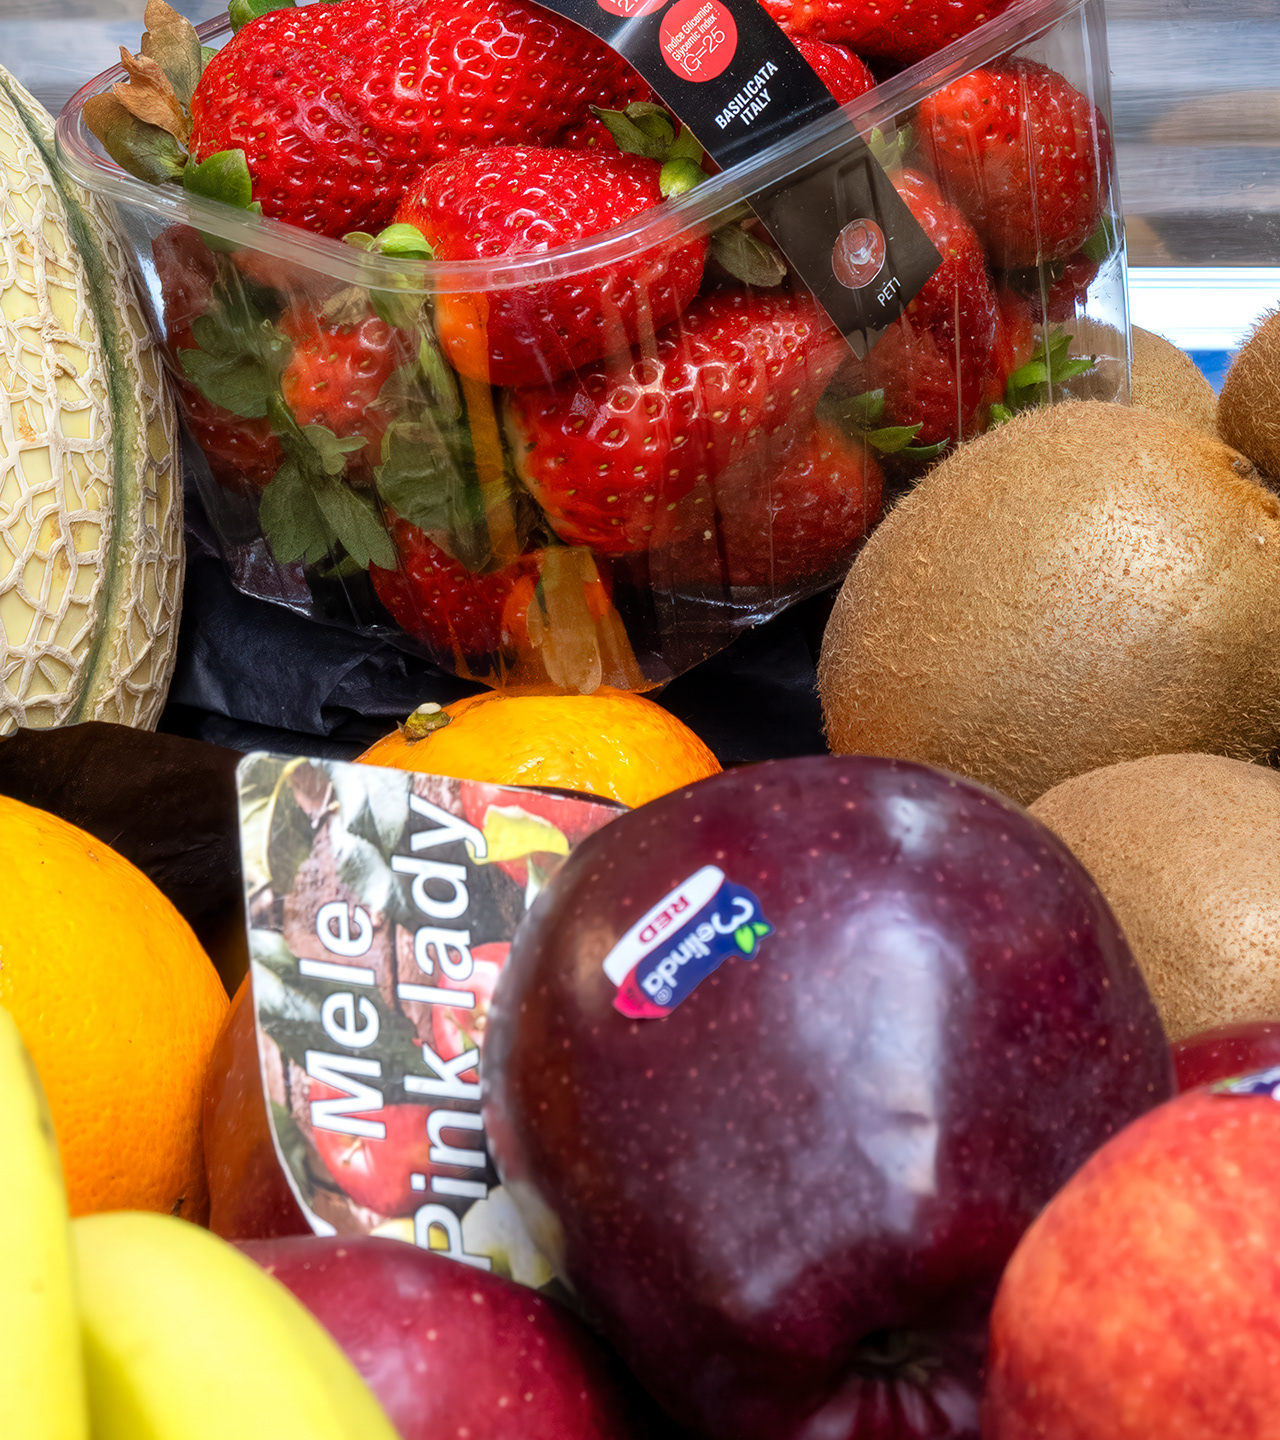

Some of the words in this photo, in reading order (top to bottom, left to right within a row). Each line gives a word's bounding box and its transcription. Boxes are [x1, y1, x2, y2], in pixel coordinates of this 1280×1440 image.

[683, 2, 713, 34] Glicemico
[672, 29, 702, 62] Glycemic
[680, 25, 725, 76] IG=25
[714, 61, 778, 129] BASILICATA
[739, 88, 772, 126] ITALY
[877, 277, 903, 307] PET1
[390, 792, 489, 1010] lady
[639, 895, 690, 943] RED
[641, 896, 755, 996] Melinda
[298, 899, 388, 1142] Mele
[403, 1041, 493, 1271] Pink
